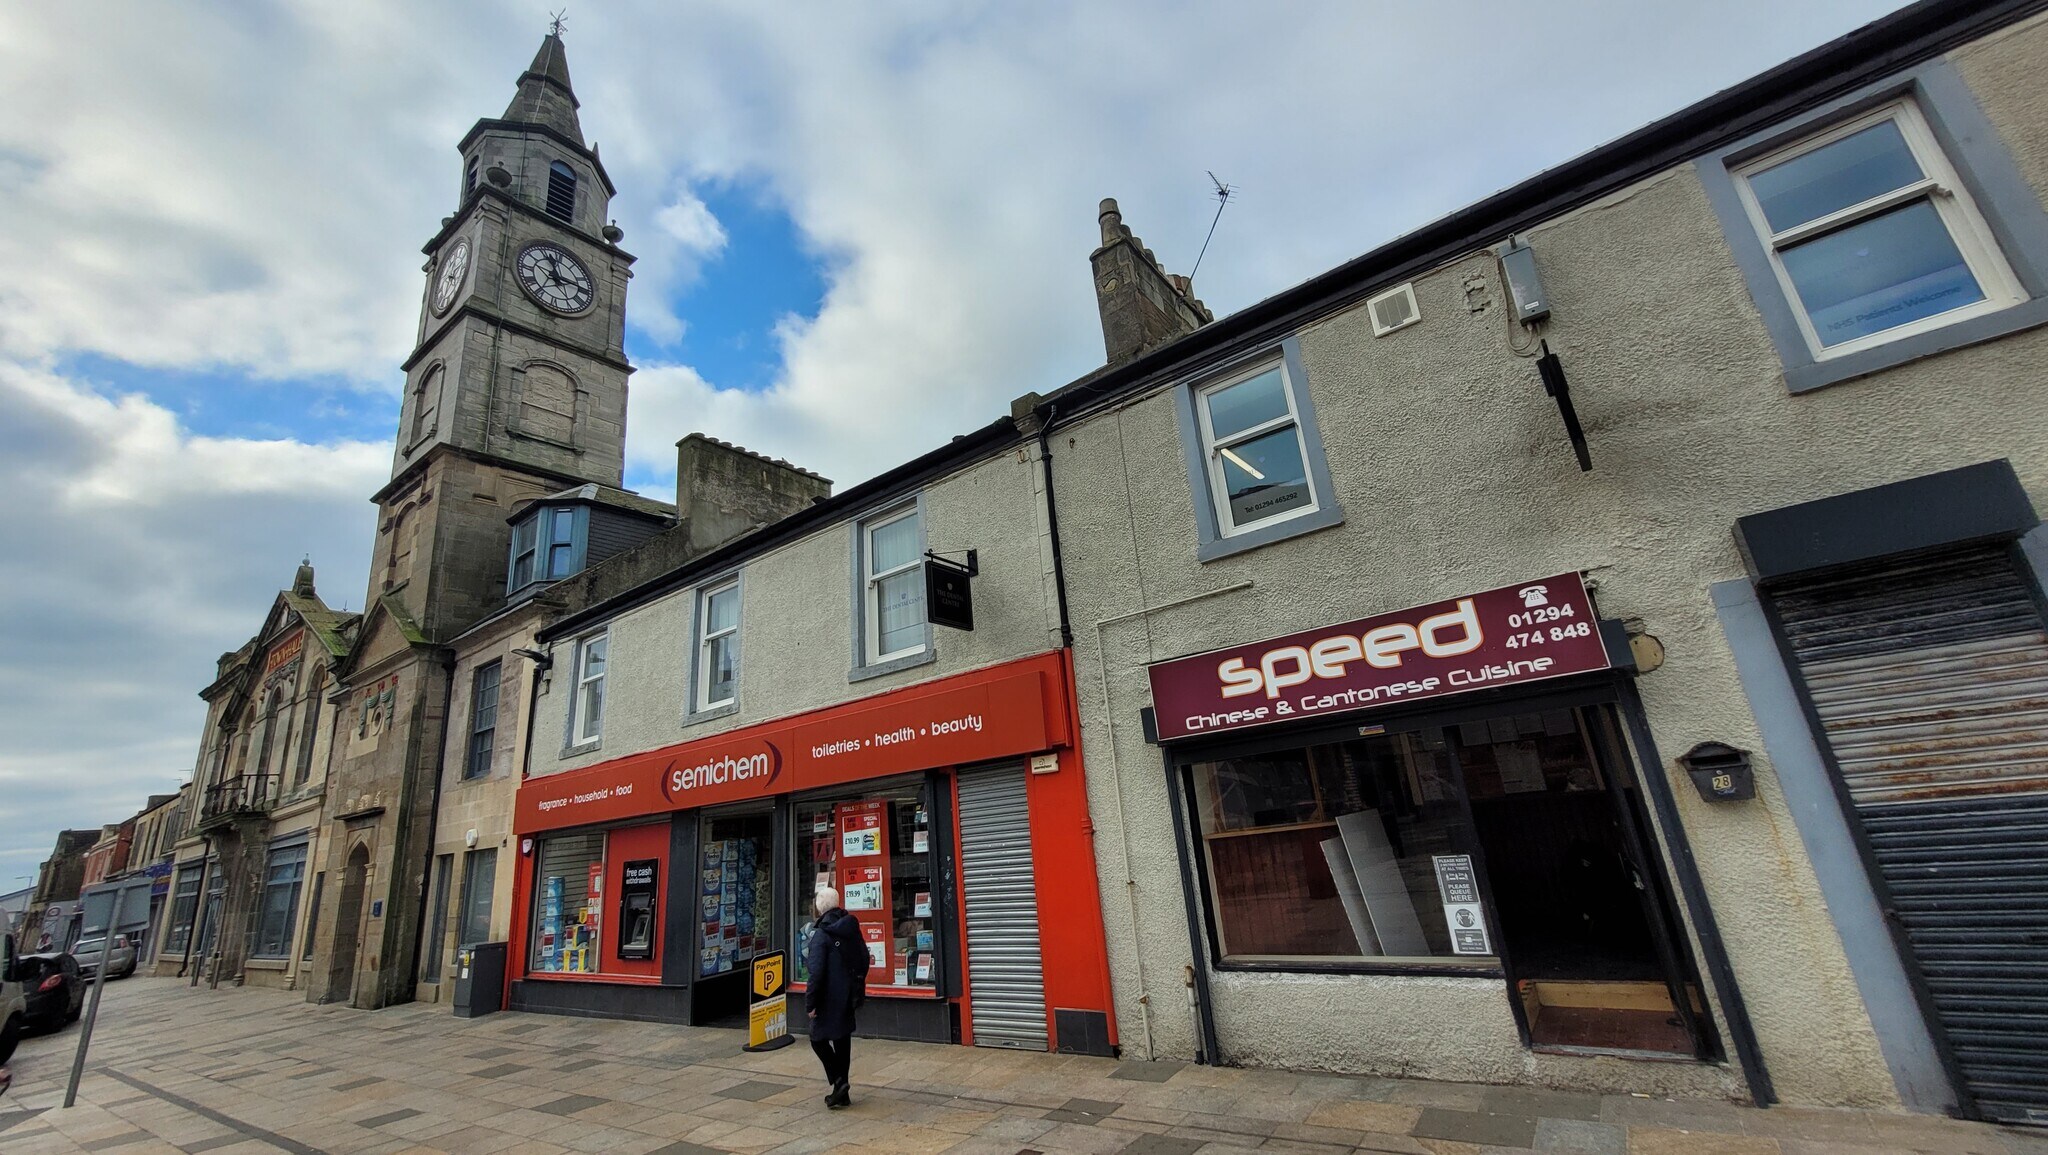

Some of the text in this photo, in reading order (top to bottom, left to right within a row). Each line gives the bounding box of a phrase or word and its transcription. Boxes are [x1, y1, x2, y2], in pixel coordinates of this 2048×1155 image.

[1827, 286, 1961, 332] NHS Patients Welcome
[1255, 500, 1274, 511] 01294
[1275, 492, 1297, 504] 465292
[1508, 603, 1574, 628] 01294
[1218, 597, 1484, 700] speed
[1506, 622, 1591, 649] 474 848
[1185, 656, 1554, 731] Chinese & Cantonese Cuisine
[812, 714, 983, 758] toiletries health beauty
[672, 752, 768, 792] semichem
[1714, 776, 1730, 789] 28
[539, 783, 633, 811] fragrance household food
[845, 836, 859, 845] £10.99
[626, 865, 652, 877] free cash
[756, 959, 781, 971] PayPoint
